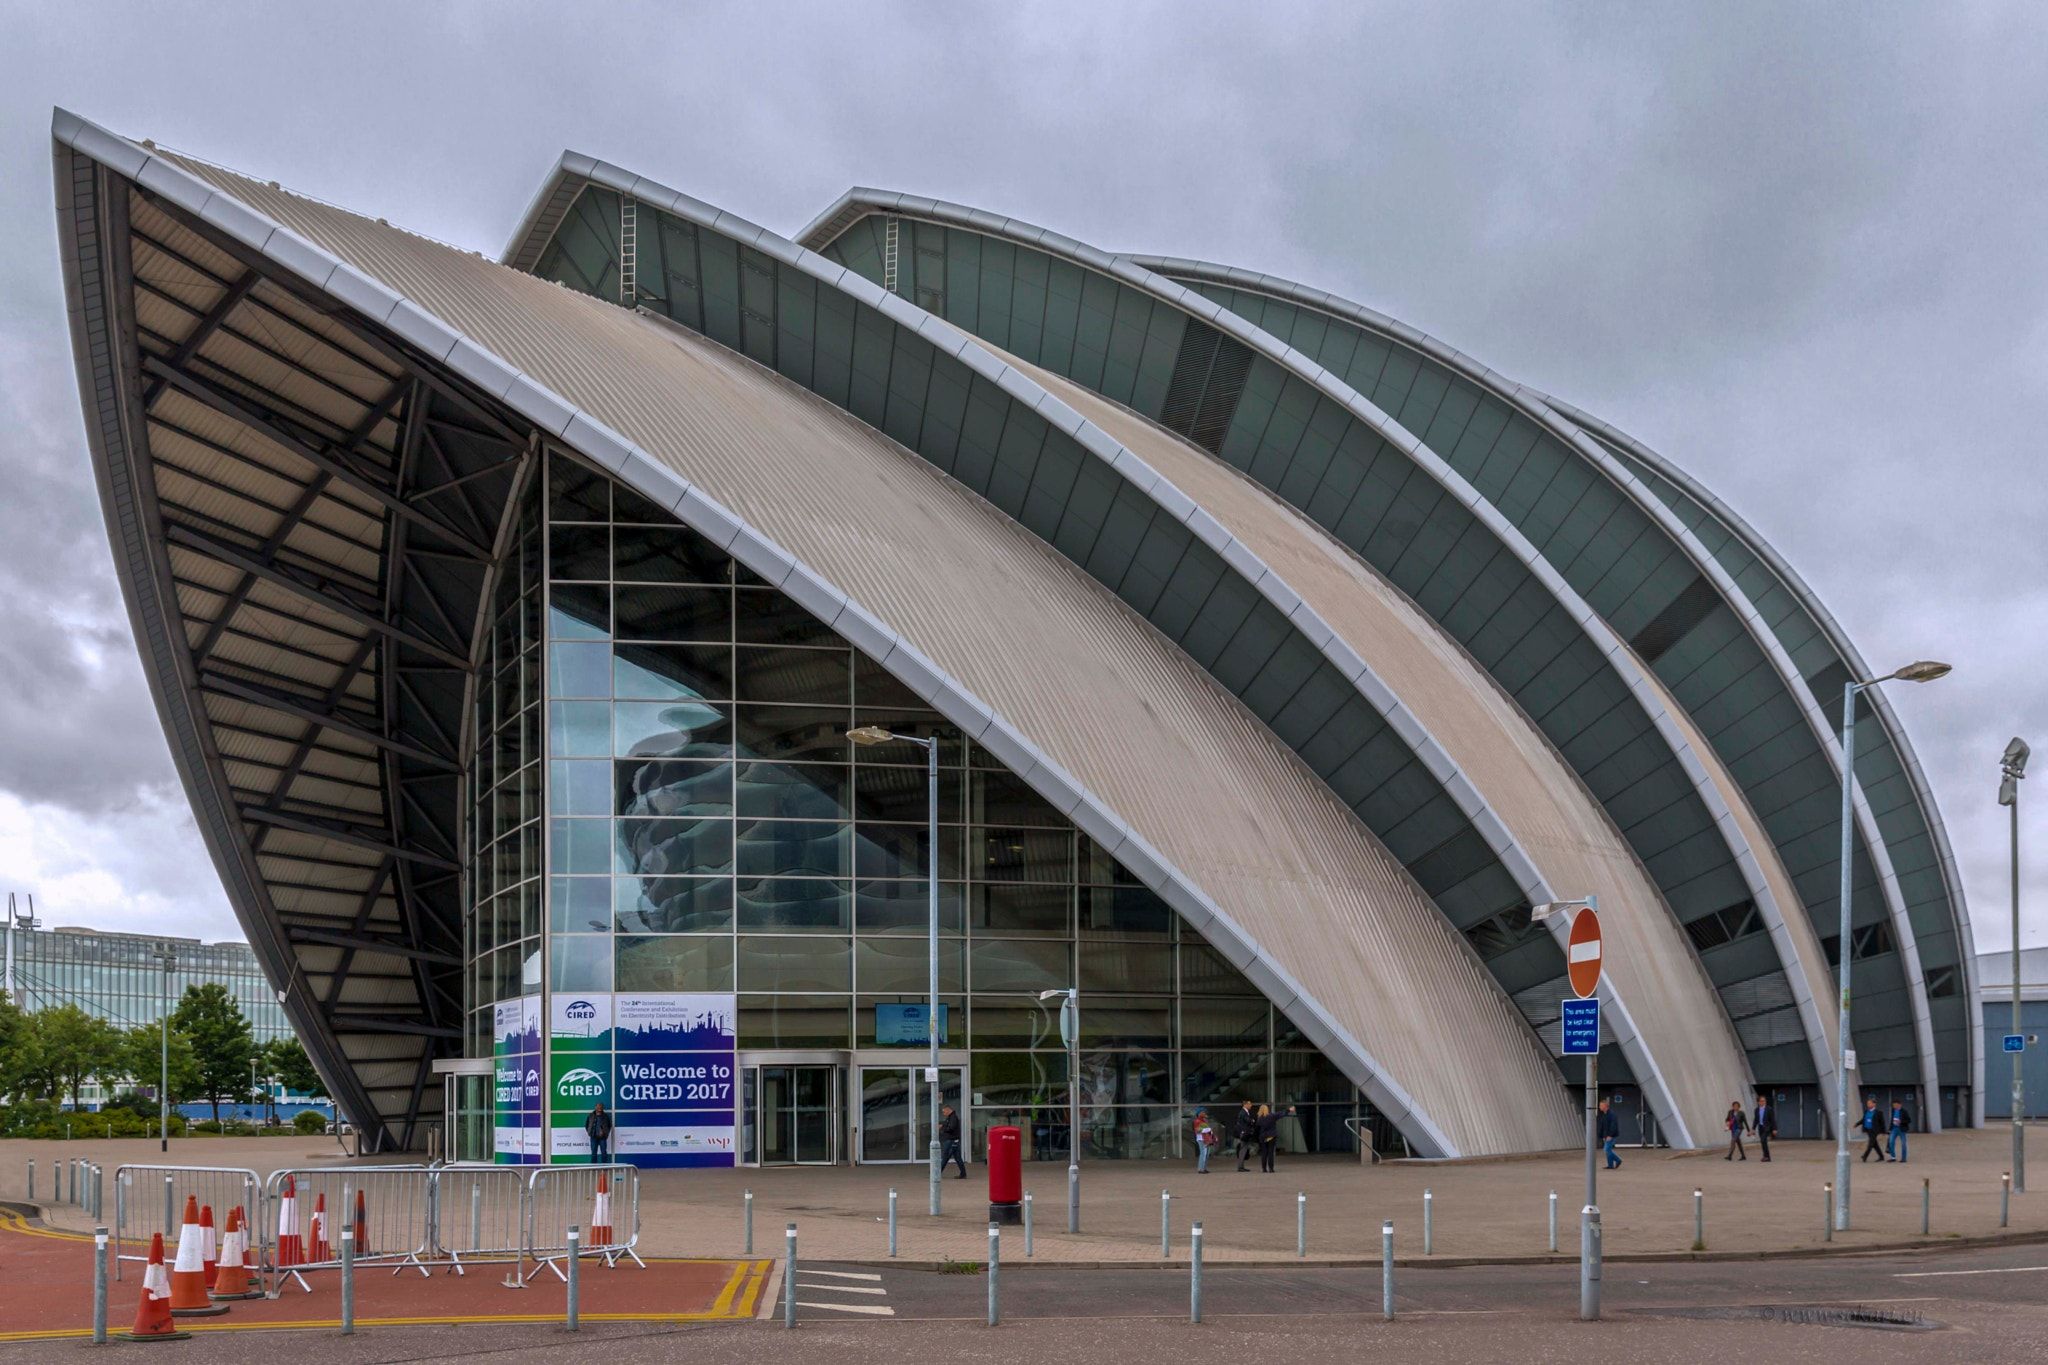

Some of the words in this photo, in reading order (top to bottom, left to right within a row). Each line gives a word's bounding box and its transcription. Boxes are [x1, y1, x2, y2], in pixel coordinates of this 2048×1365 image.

[567, 1011, 595, 1019] CIRED
[628, 1012, 655, 1020] Electricity
[495, 1067, 516, 1082] Welcome
[516, 1067, 522, 1082] to
[621, 1063, 706, 1079] Welcome
[711, 1063, 730, 1079] to
[496, 1086, 511, 1103] CIRED
[511, 1086, 522, 1102] 2017
[525, 1086, 540, 1097] CIRED
[560, 1085, 604, 1096] CIRED
[620, 1084, 683, 1101] CIRED
[686, 1083, 731, 1100] 2017
[707, 1137, 731, 1149] wsp
